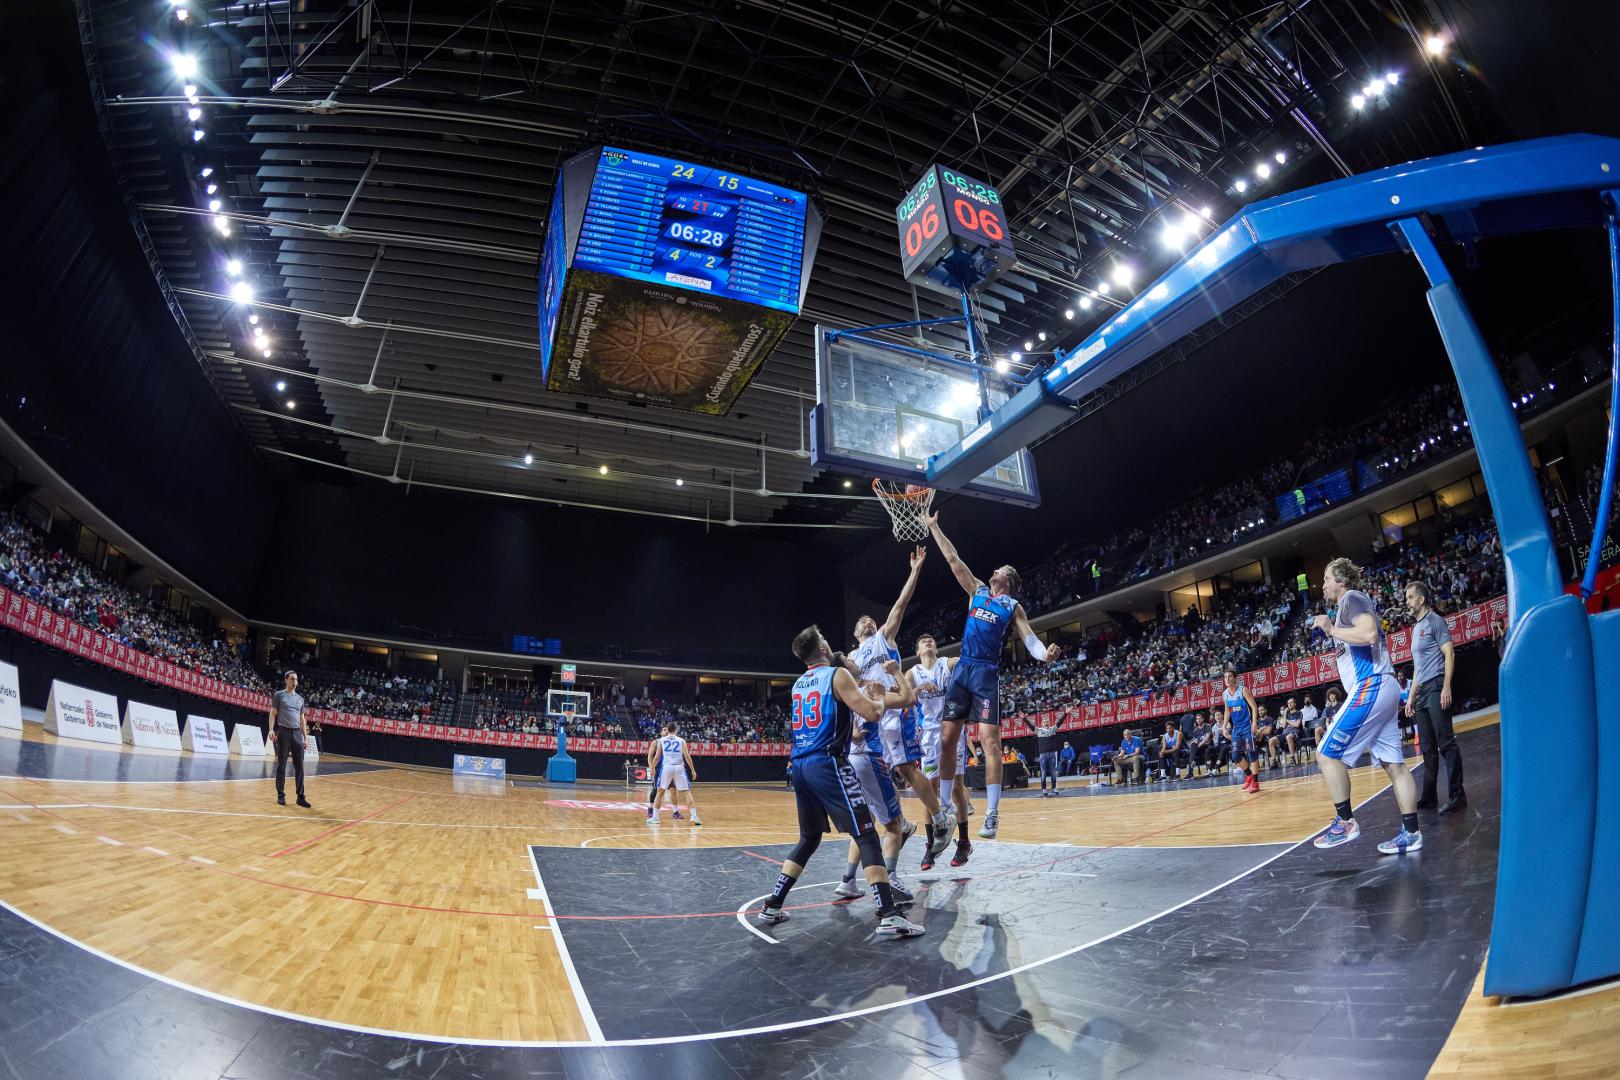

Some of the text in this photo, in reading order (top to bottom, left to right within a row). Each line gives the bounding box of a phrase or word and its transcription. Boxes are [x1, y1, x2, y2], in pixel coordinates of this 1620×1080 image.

[672, 164, 695, 179] 24
[718, 175, 739, 190] 15
[956, 187, 990, 206] MONDO
[954, 199, 1004, 241] 06
[670, 222, 723, 247] 06:28
[905, 204, 939, 257] 06
[669, 249, 681, 261] 4
[705, 256, 715, 268] 2
[583, 292, 604, 316] Noiz
[572, 316, 597, 358] elkartuko
[705, 372, 732, 403] ¿Cuándo
[726, 323, 764, 372] quedamos?
[1466, 608, 1481, 629] 75
[1490, 599, 1506, 620] 75
[1391, 631, 1406, 651] 75
[1275, 666, 1288, 683] 75
[1297, 661, 1311, 677] 75
[1211, 680, 1223, 696] 75
[1253, 671, 1266, 687] 75
[1191, 684, 1204, 700] 75
[95, 709, 113, 720] Gobierno
[792, 690, 822, 730] 33
[664, 740, 680, 753] 22
